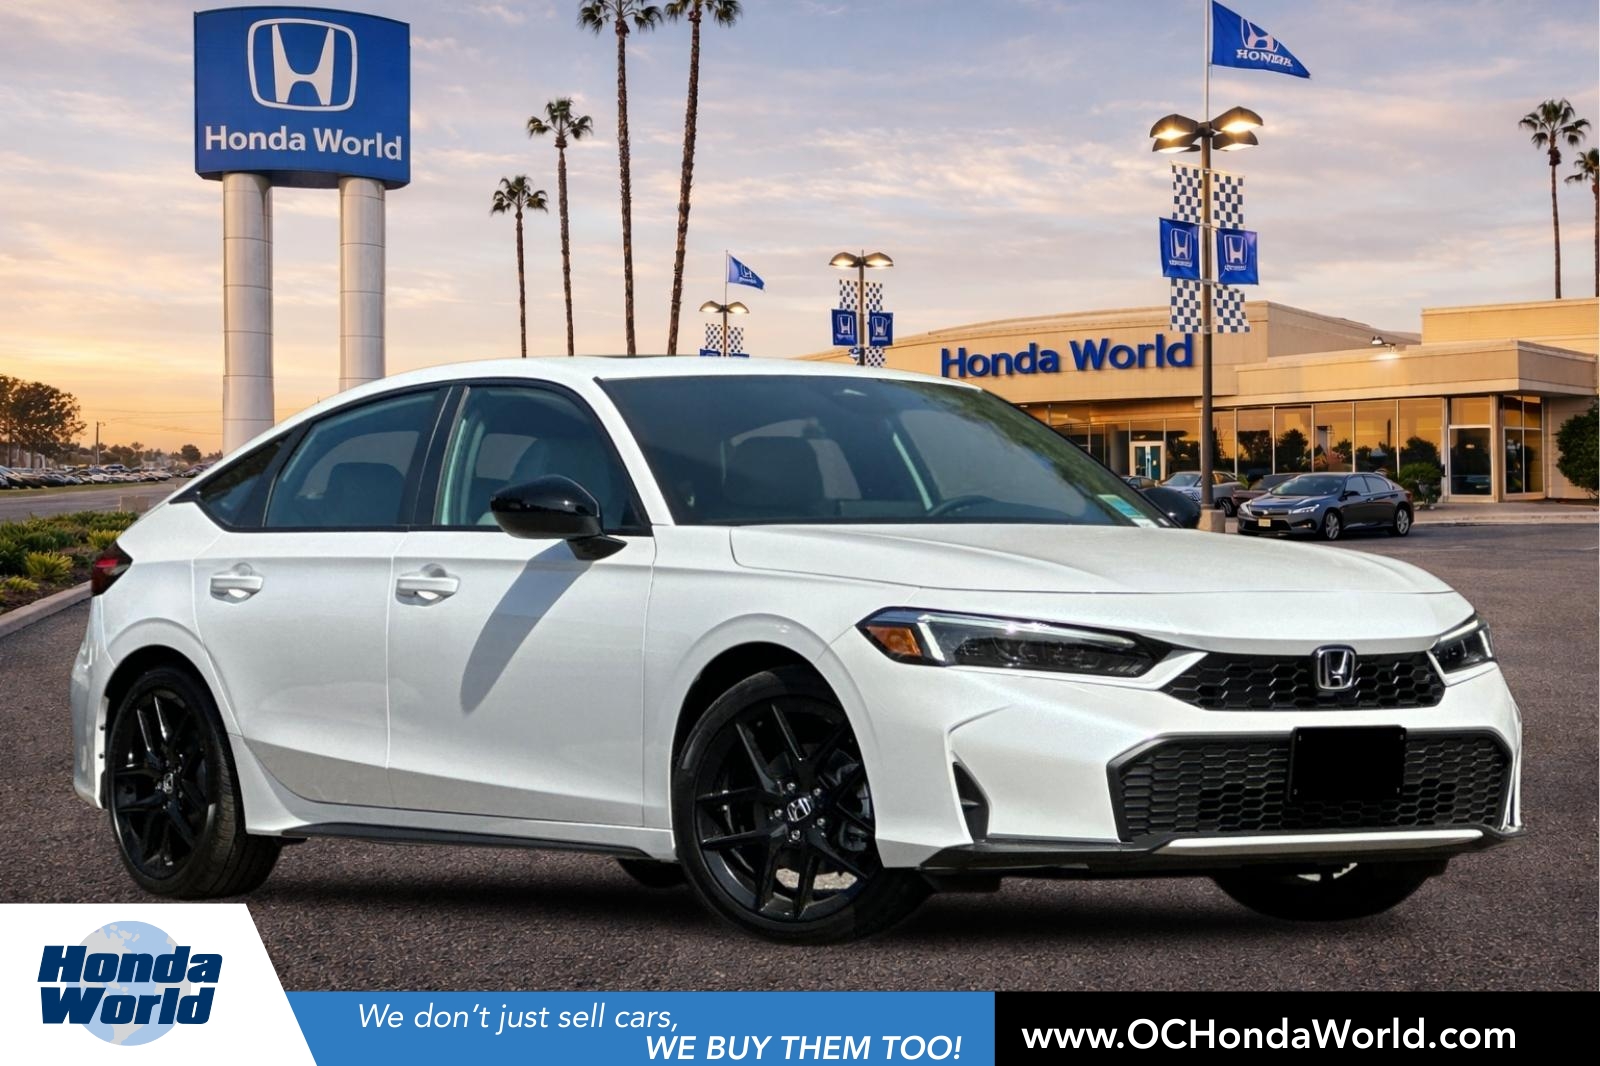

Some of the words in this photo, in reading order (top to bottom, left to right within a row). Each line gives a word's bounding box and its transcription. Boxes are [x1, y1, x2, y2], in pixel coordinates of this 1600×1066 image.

[205, 125, 306, 151] Honda
[313, 127, 403, 161] World
[940, 342, 1061, 379] Honda
[1069, 333, 1194, 371] World
